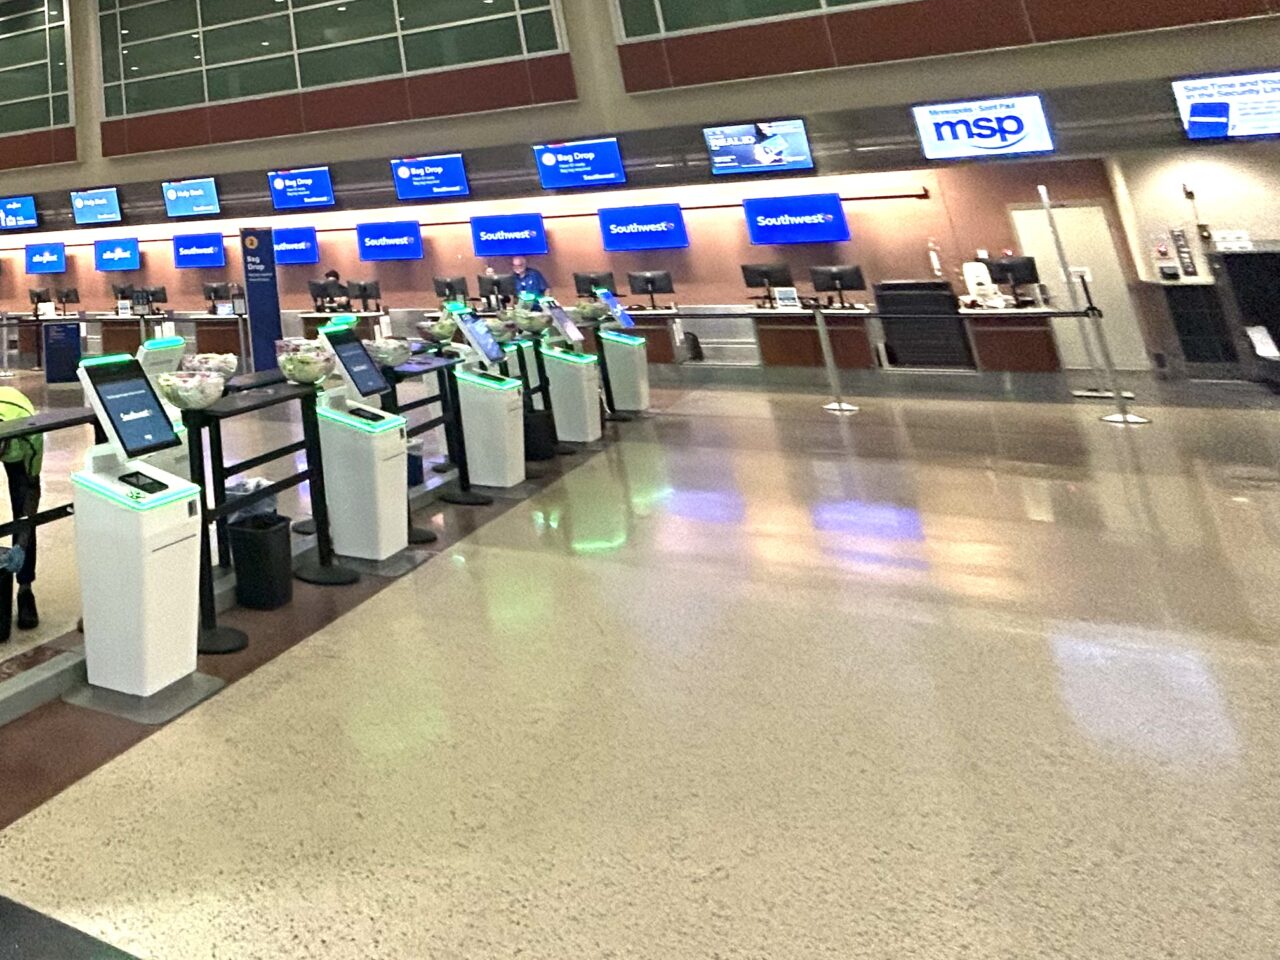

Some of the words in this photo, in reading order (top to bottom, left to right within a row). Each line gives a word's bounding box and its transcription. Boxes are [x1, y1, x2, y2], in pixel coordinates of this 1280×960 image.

[933, 115, 1024, 142] msp
[556, 153, 573, 163] Bag
[573, 152, 595, 161] Drop
[410, 167, 425, 176] Bag
[425, 166, 444, 174] Drop
[285, 179, 297, 187] Bag
[297, 178, 313, 186] Drop
[756, 213, 825, 227] Southwest
[609, 221, 667, 234] Southwest
[480, 229, 530, 241] Southwest
[364, 236, 409, 247] Southwest
[179, 246, 214, 256] Southwest
[246, 255, 260, 264] Bag
[247, 263, 265, 272] Drop
